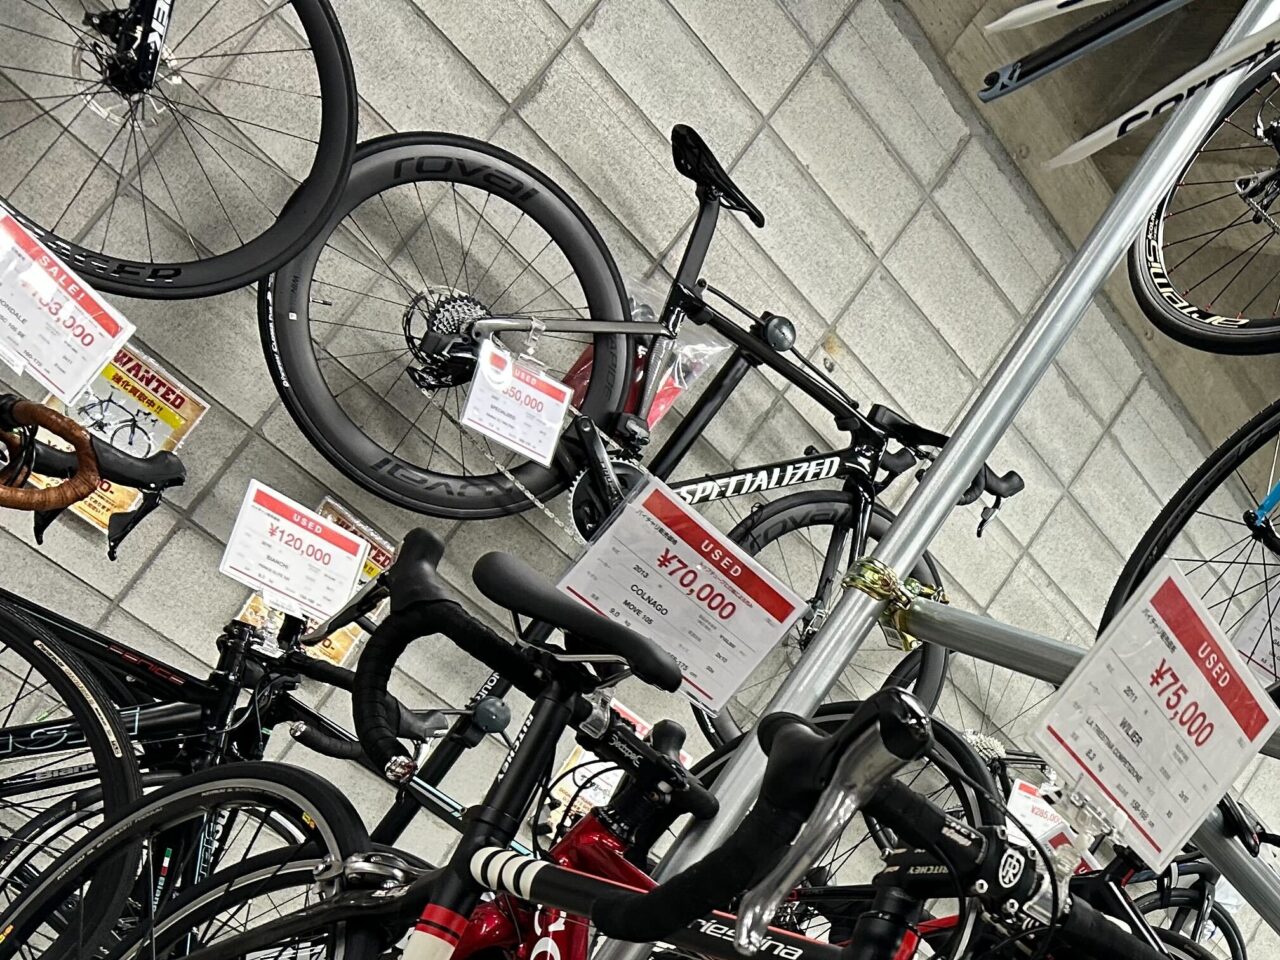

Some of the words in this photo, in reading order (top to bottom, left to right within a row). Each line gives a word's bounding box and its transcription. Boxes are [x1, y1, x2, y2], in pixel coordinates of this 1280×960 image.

[35, 254, 89, 302] SALE!
[113, 349, 186, 410] WANTED
[514, 368, 537, 385] USED
[675, 456, 840, 505] SPECIALIZED
[291, 513, 324, 535] USED
[265, 523, 334, 567] ¥120,000
[699, 539, 744, 579] USED
[633, 563, 650, 579] 2013
[652, 547, 739, 626] ¥70,000
[609, 607, 621, 618] 9.0
[622, 598, 642, 616] MOVE
[641, 613, 654, 626] 105
[629, 582, 670, 618] COLNAGO
[1198, 641, 1230, 687] USED
[1122, 686, 1140, 703] 2011
[1150, 658, 1215, 747] ¥75,000
[1117, 717, 1145, 747] WILIER
